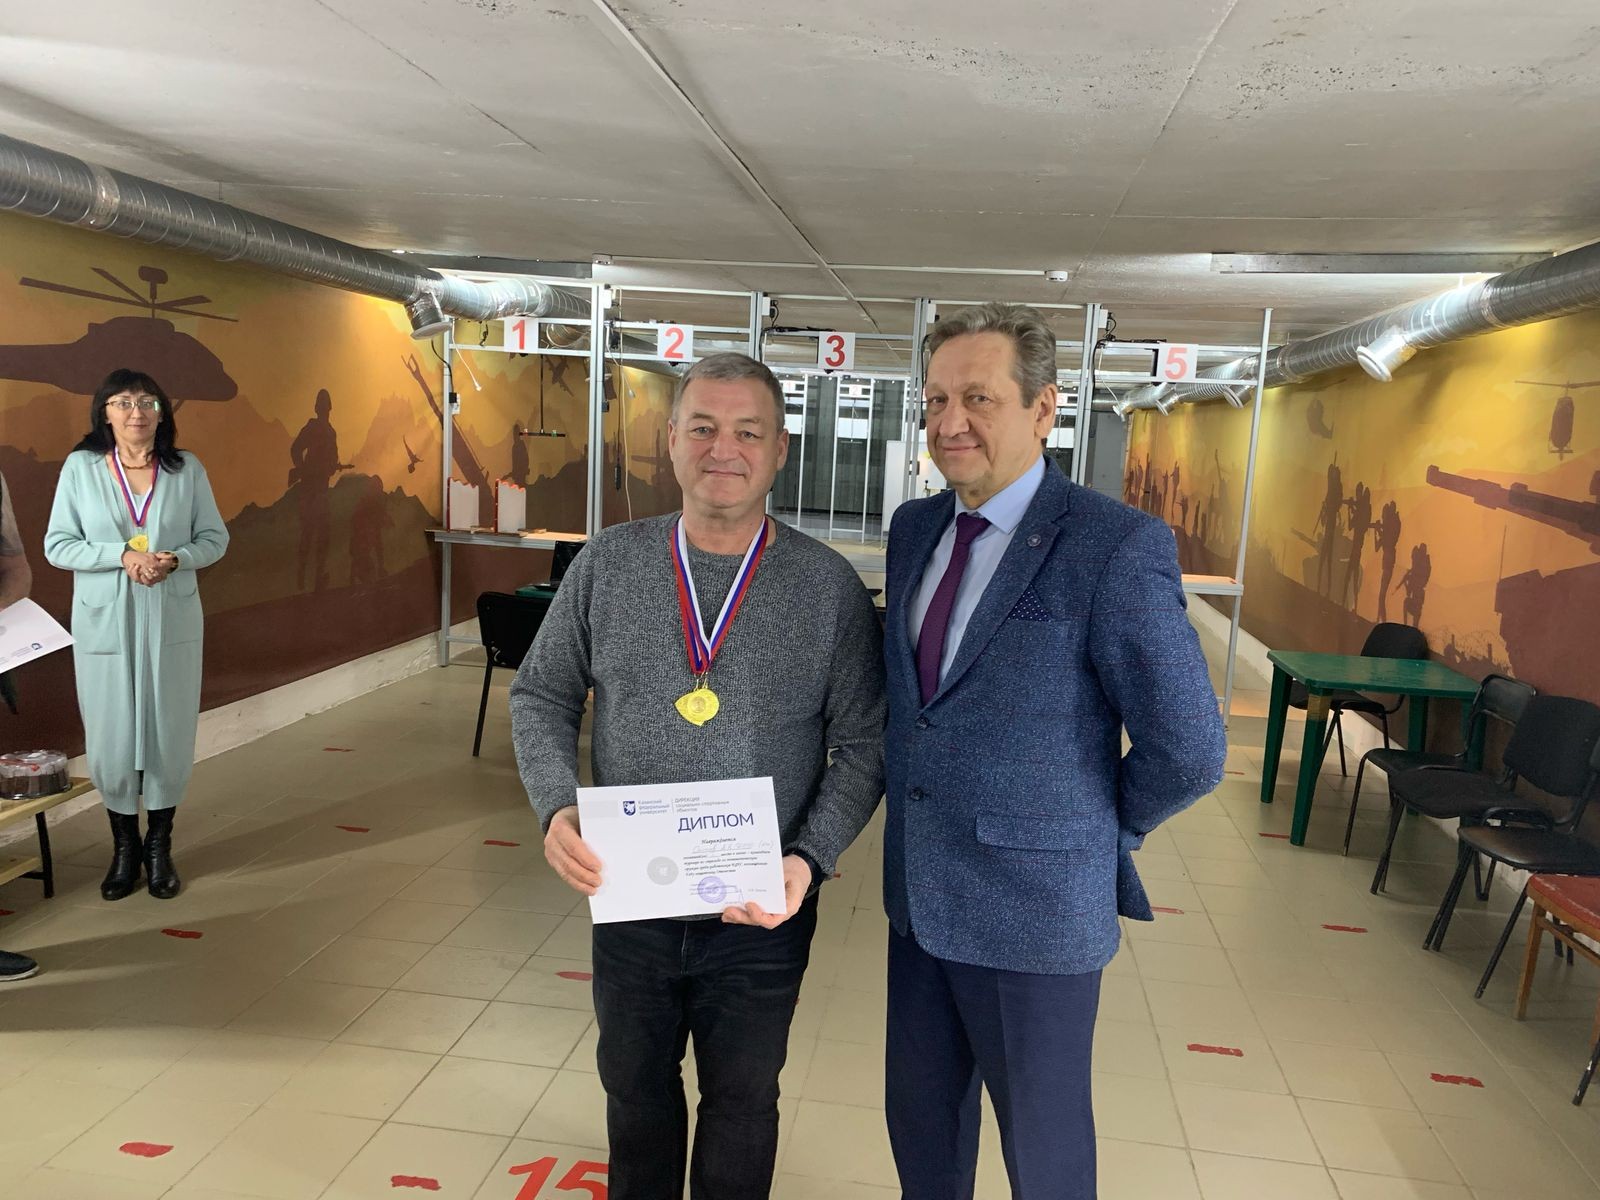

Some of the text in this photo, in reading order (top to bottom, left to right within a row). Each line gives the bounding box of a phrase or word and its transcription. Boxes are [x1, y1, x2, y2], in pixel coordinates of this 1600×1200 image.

[511, 319, 526, 350] 1
[663, 327, 685, 359] 2
[825, 335, 846, 367] 3
[1165, 347, 1188, 380] 5
[678, 812, 754, 833] ДИПЛОМ
